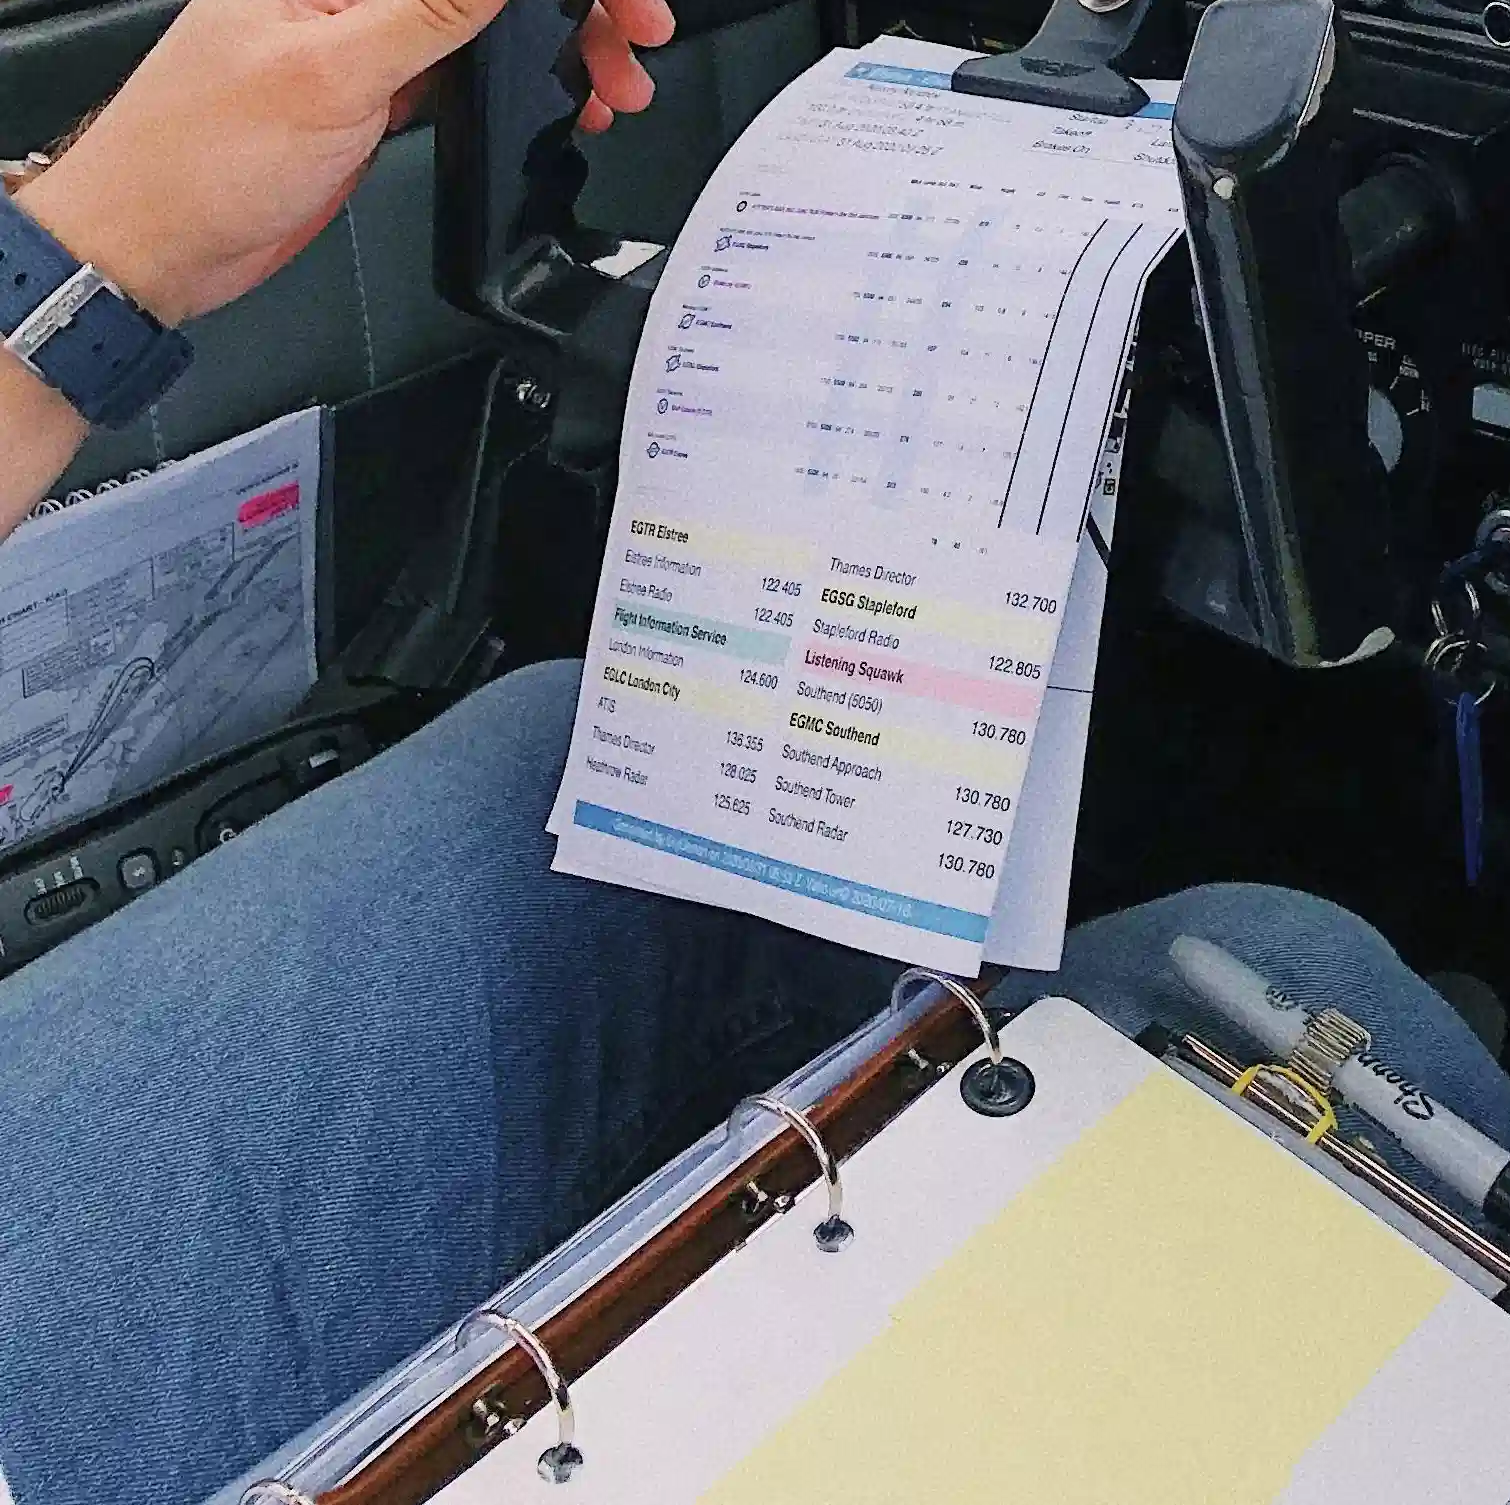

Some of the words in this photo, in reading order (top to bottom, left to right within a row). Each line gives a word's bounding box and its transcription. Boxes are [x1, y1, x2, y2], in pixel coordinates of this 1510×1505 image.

[630, 519, 655, 537] EGTR
[830, 556, 871, 580] Thames
[873, 565, 918, 587] Director
[820, 588, 855, 607] EGSG
[856, 595, 917, 620] Stapleford
[614, 607, 637, 626] Flight
[638, 614, 690, 637] Information
[690, 625, 727, 646] Service
[812, 618, 867, 643] Stapleford
[868, 630, 900, 650] Radio
[739, 669, 779, 689] 124.600
[804, 649, 855, 677] Listening
[858, 662, 904, 684] Squawk
[988, 655, 1041, 680] 122.805
[627, 673, 661, 695] London
[662, 681, 680, 701] City
[796, 680, 847, 705] Southend
[848, 692, 883, 714] (5050)
[789, 712, 823, 733] EGMC
[825, 720, 880, 746] Southend
[971, 720, 1026, 746] 130.780
[781, 744, 831, 769] Southend
[831, 755, 882, 781] Approach
[714, 793, 751, 816] 125.625
[774, 775, 823, 801] Southend
[824, 787, 856, 808] Tower
[955, 786, 1011, 812] 130.780
[768, 807, 815, 834] Southend
[817, 820, 849, 842] Radar
[946, 819, 1003, 846] 127.730
[938, 853, 995, 879] 130.780
